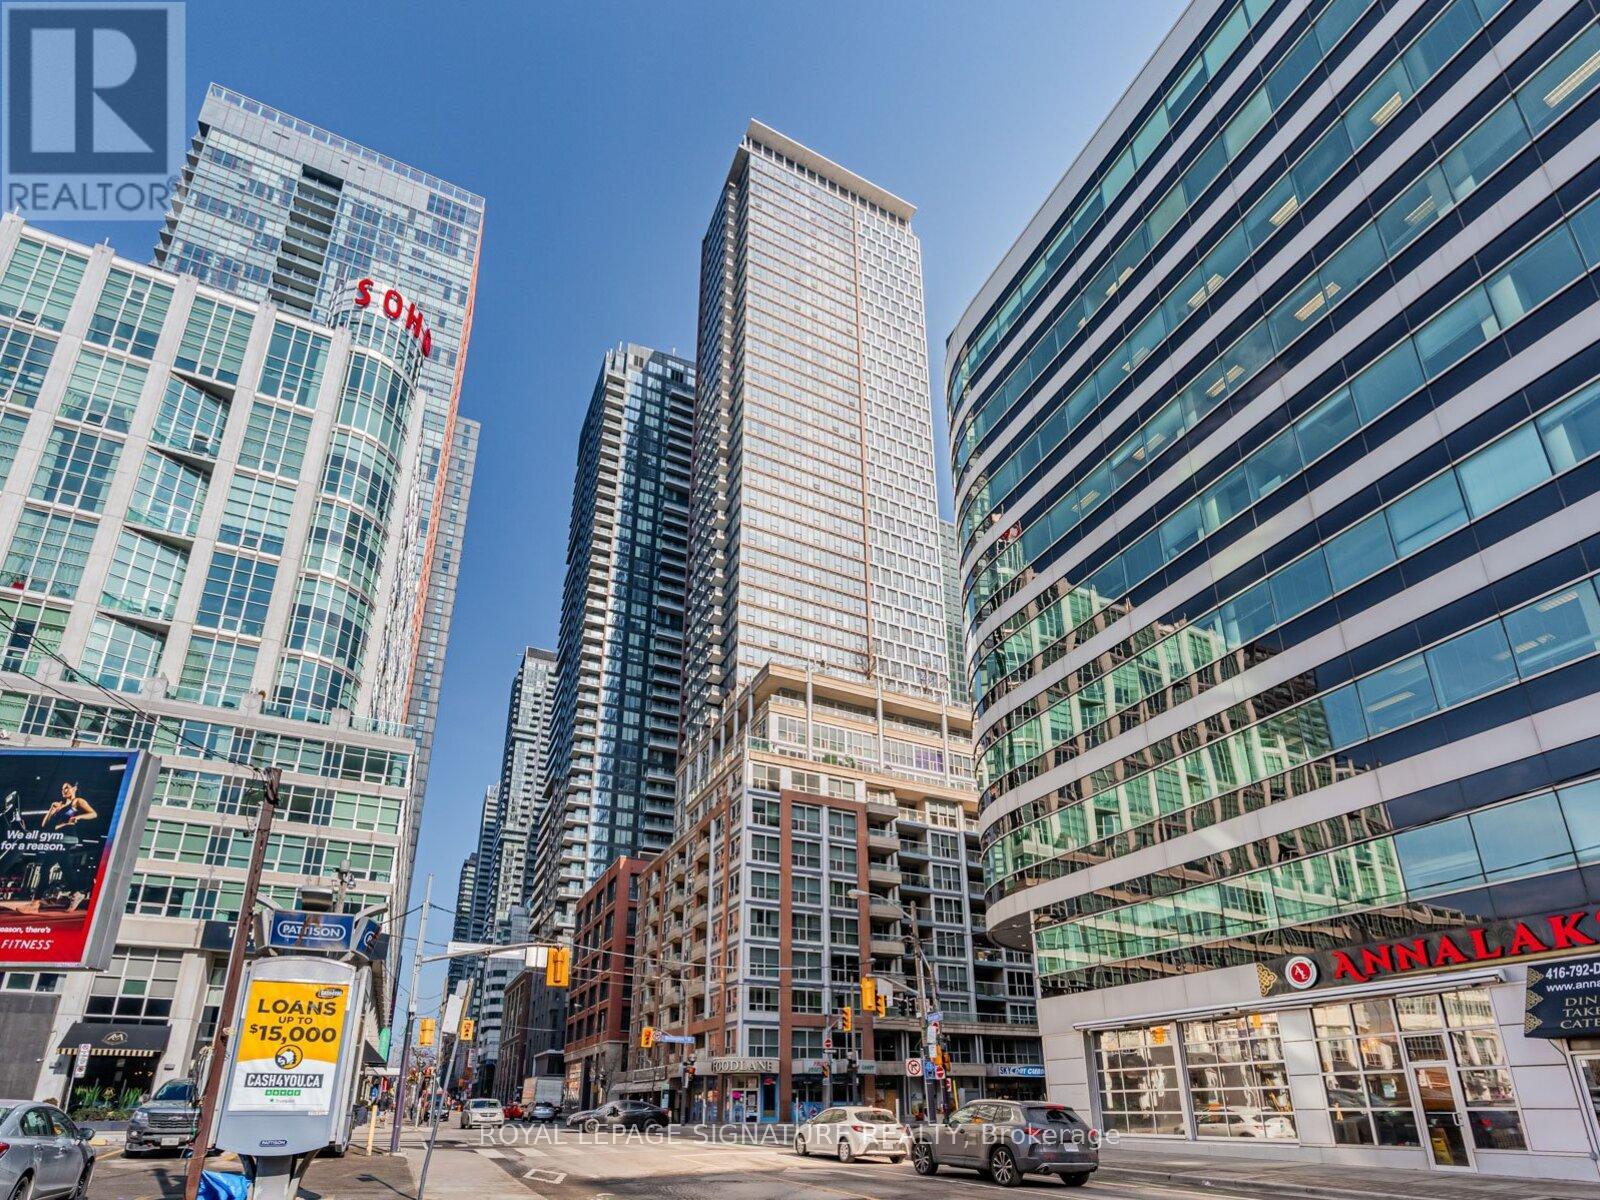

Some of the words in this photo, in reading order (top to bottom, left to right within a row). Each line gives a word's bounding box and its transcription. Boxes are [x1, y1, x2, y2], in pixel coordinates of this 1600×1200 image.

[354, 278, 432, 357] SOHO
[7, 830, 24, 839] We
[25, 830, 39, 839] all
[40, 832, 64, 842] gym
[0, 840, 17, 850] for
[26, 843, 66, 851] reason.
[25, 925, 51, 934] there's
[282, 925, 341, 937] PATTISON
[1, 939, 51, 950] FITNESS
[1333, 909, 1600, 983] ANNALAK
[1545, 962, 1600, 980] 416-792-D
[257, 998, 336, 1016] LOANS
[278, 1016, 294, 1024] UP
[298, 1017, 313, 1025] TO
[249, 1023, 337, 1045] $15,000
[246, 1073, 320, 1088] CASH4YOU.CA
